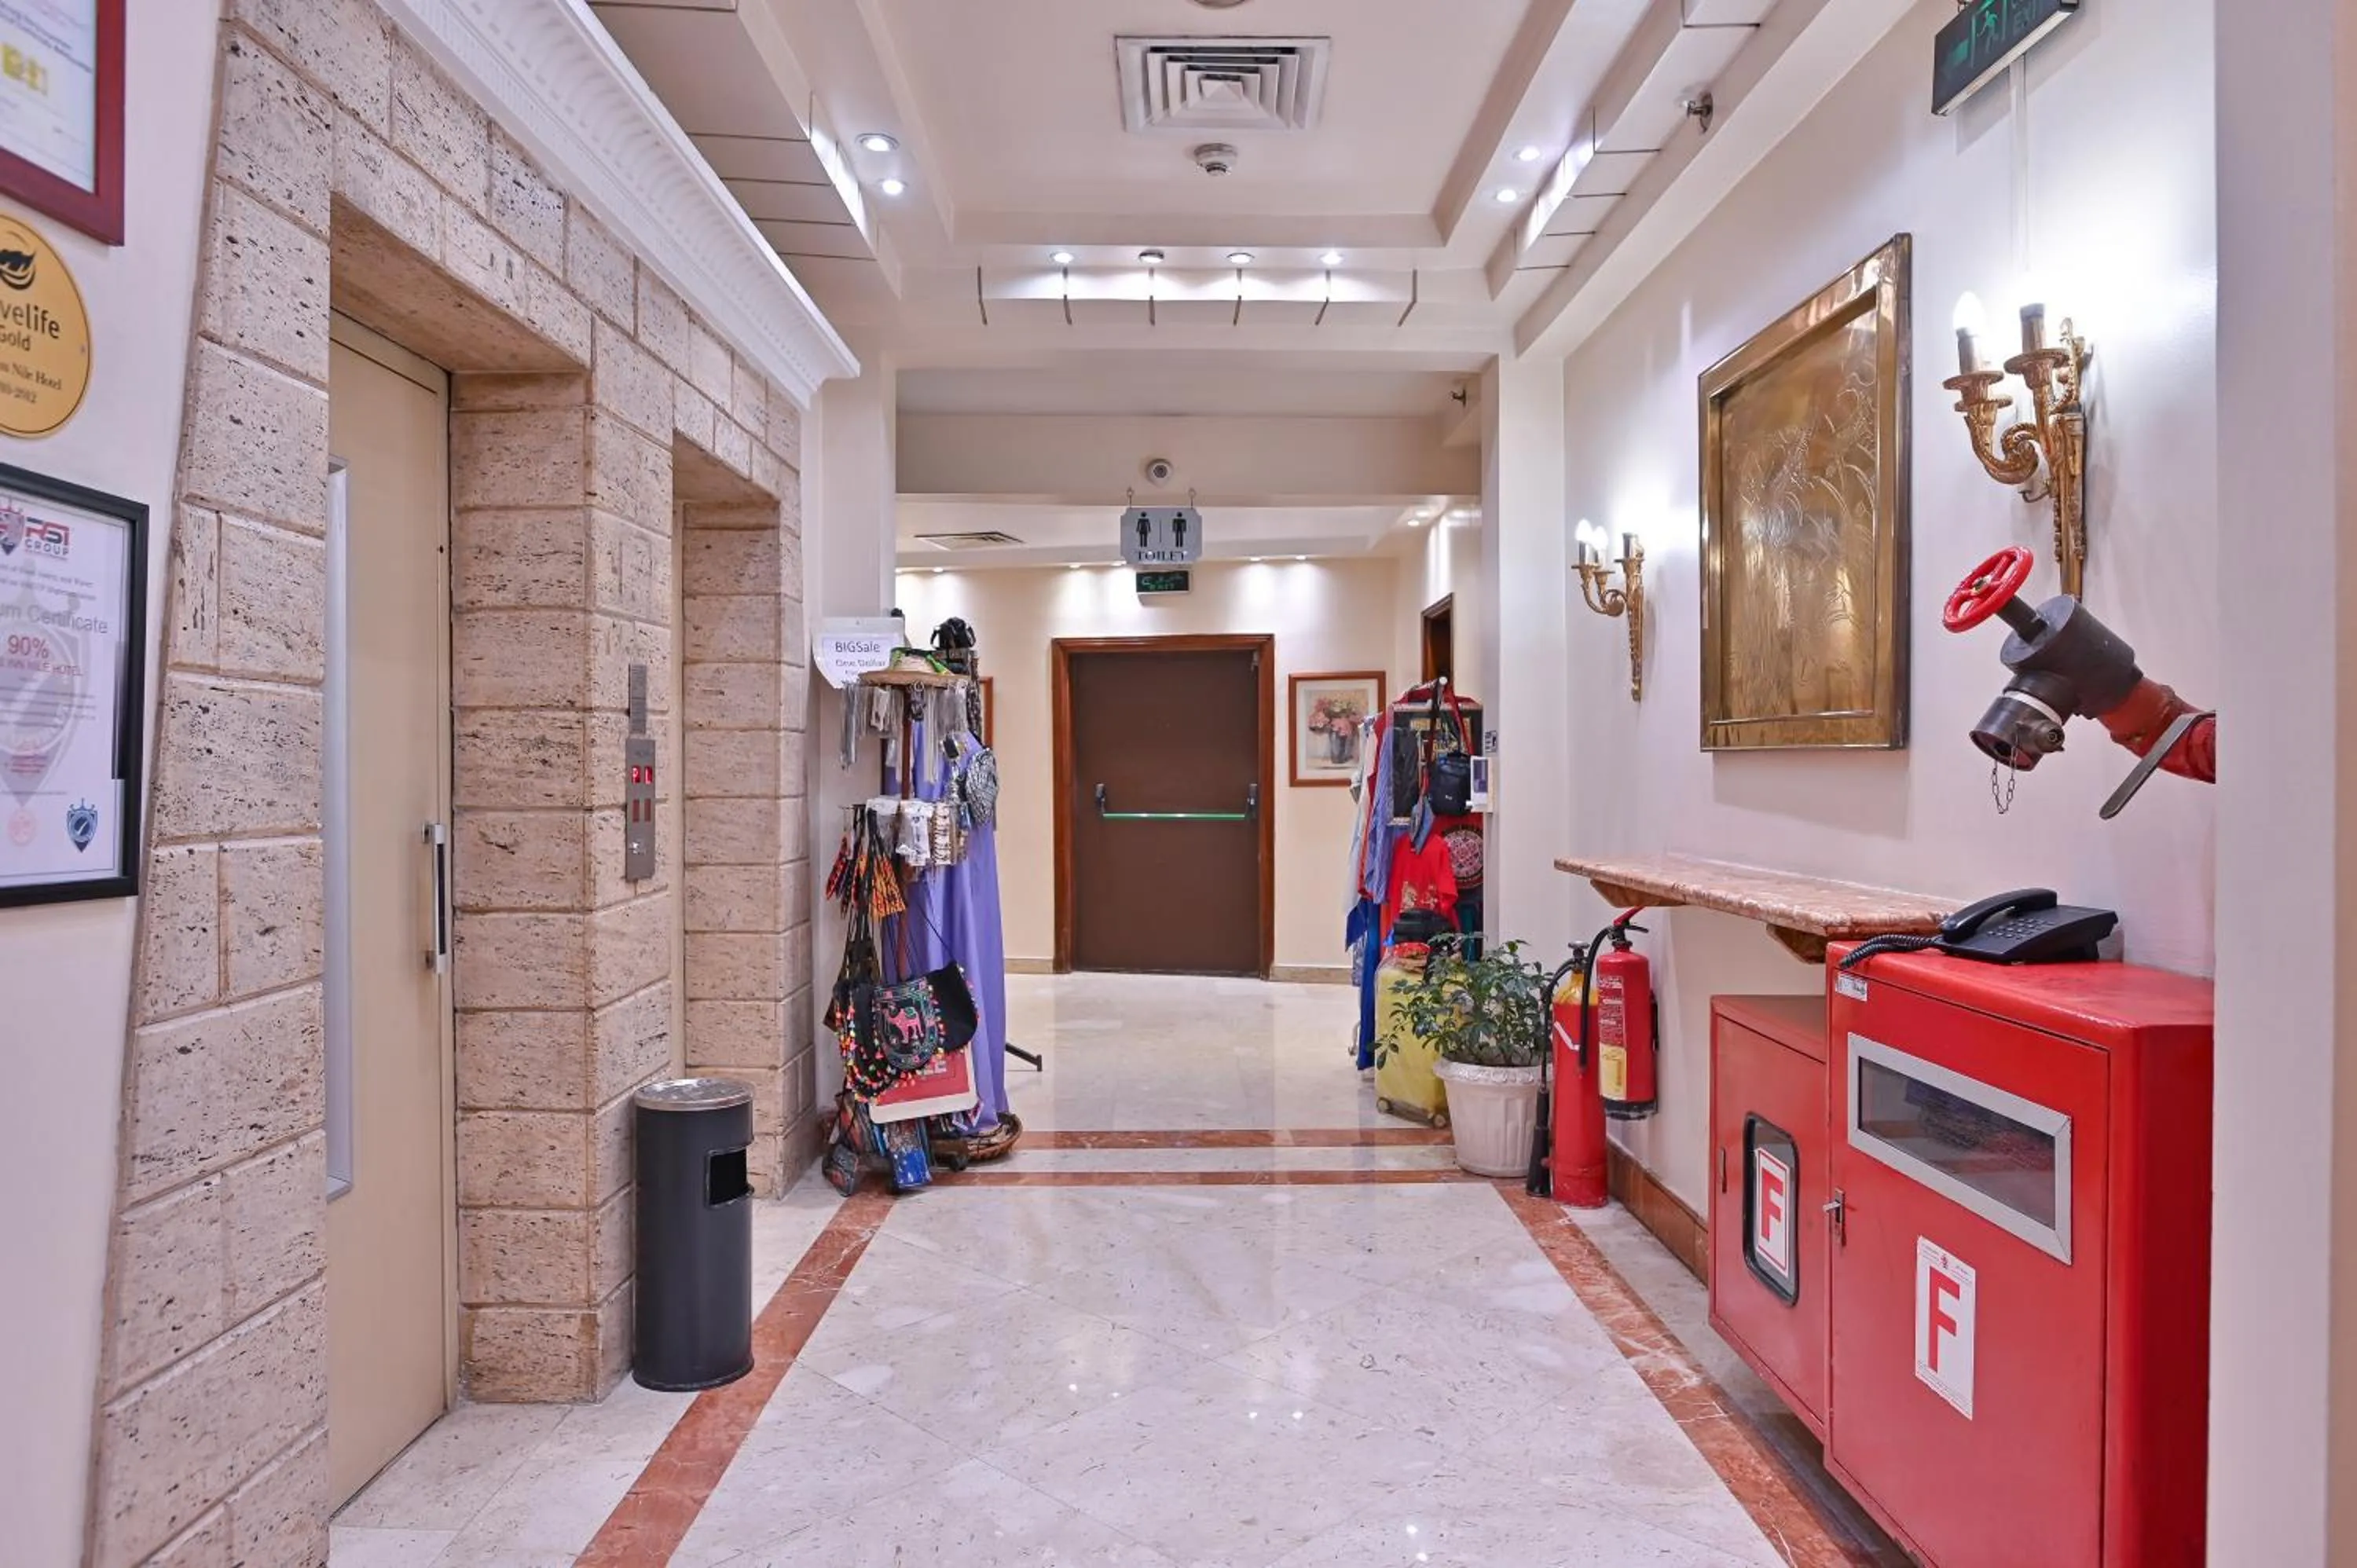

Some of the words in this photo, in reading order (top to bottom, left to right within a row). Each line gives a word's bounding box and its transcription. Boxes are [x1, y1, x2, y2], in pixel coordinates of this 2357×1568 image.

[1137, 551, 1187, 560] TOILET
[27, 604, 108, 634] Certificate
[8, 635, 49, 659] 90%
[1761, 1168, 1784, 1242] F
[1929, 1266, 1960, 1374] F
